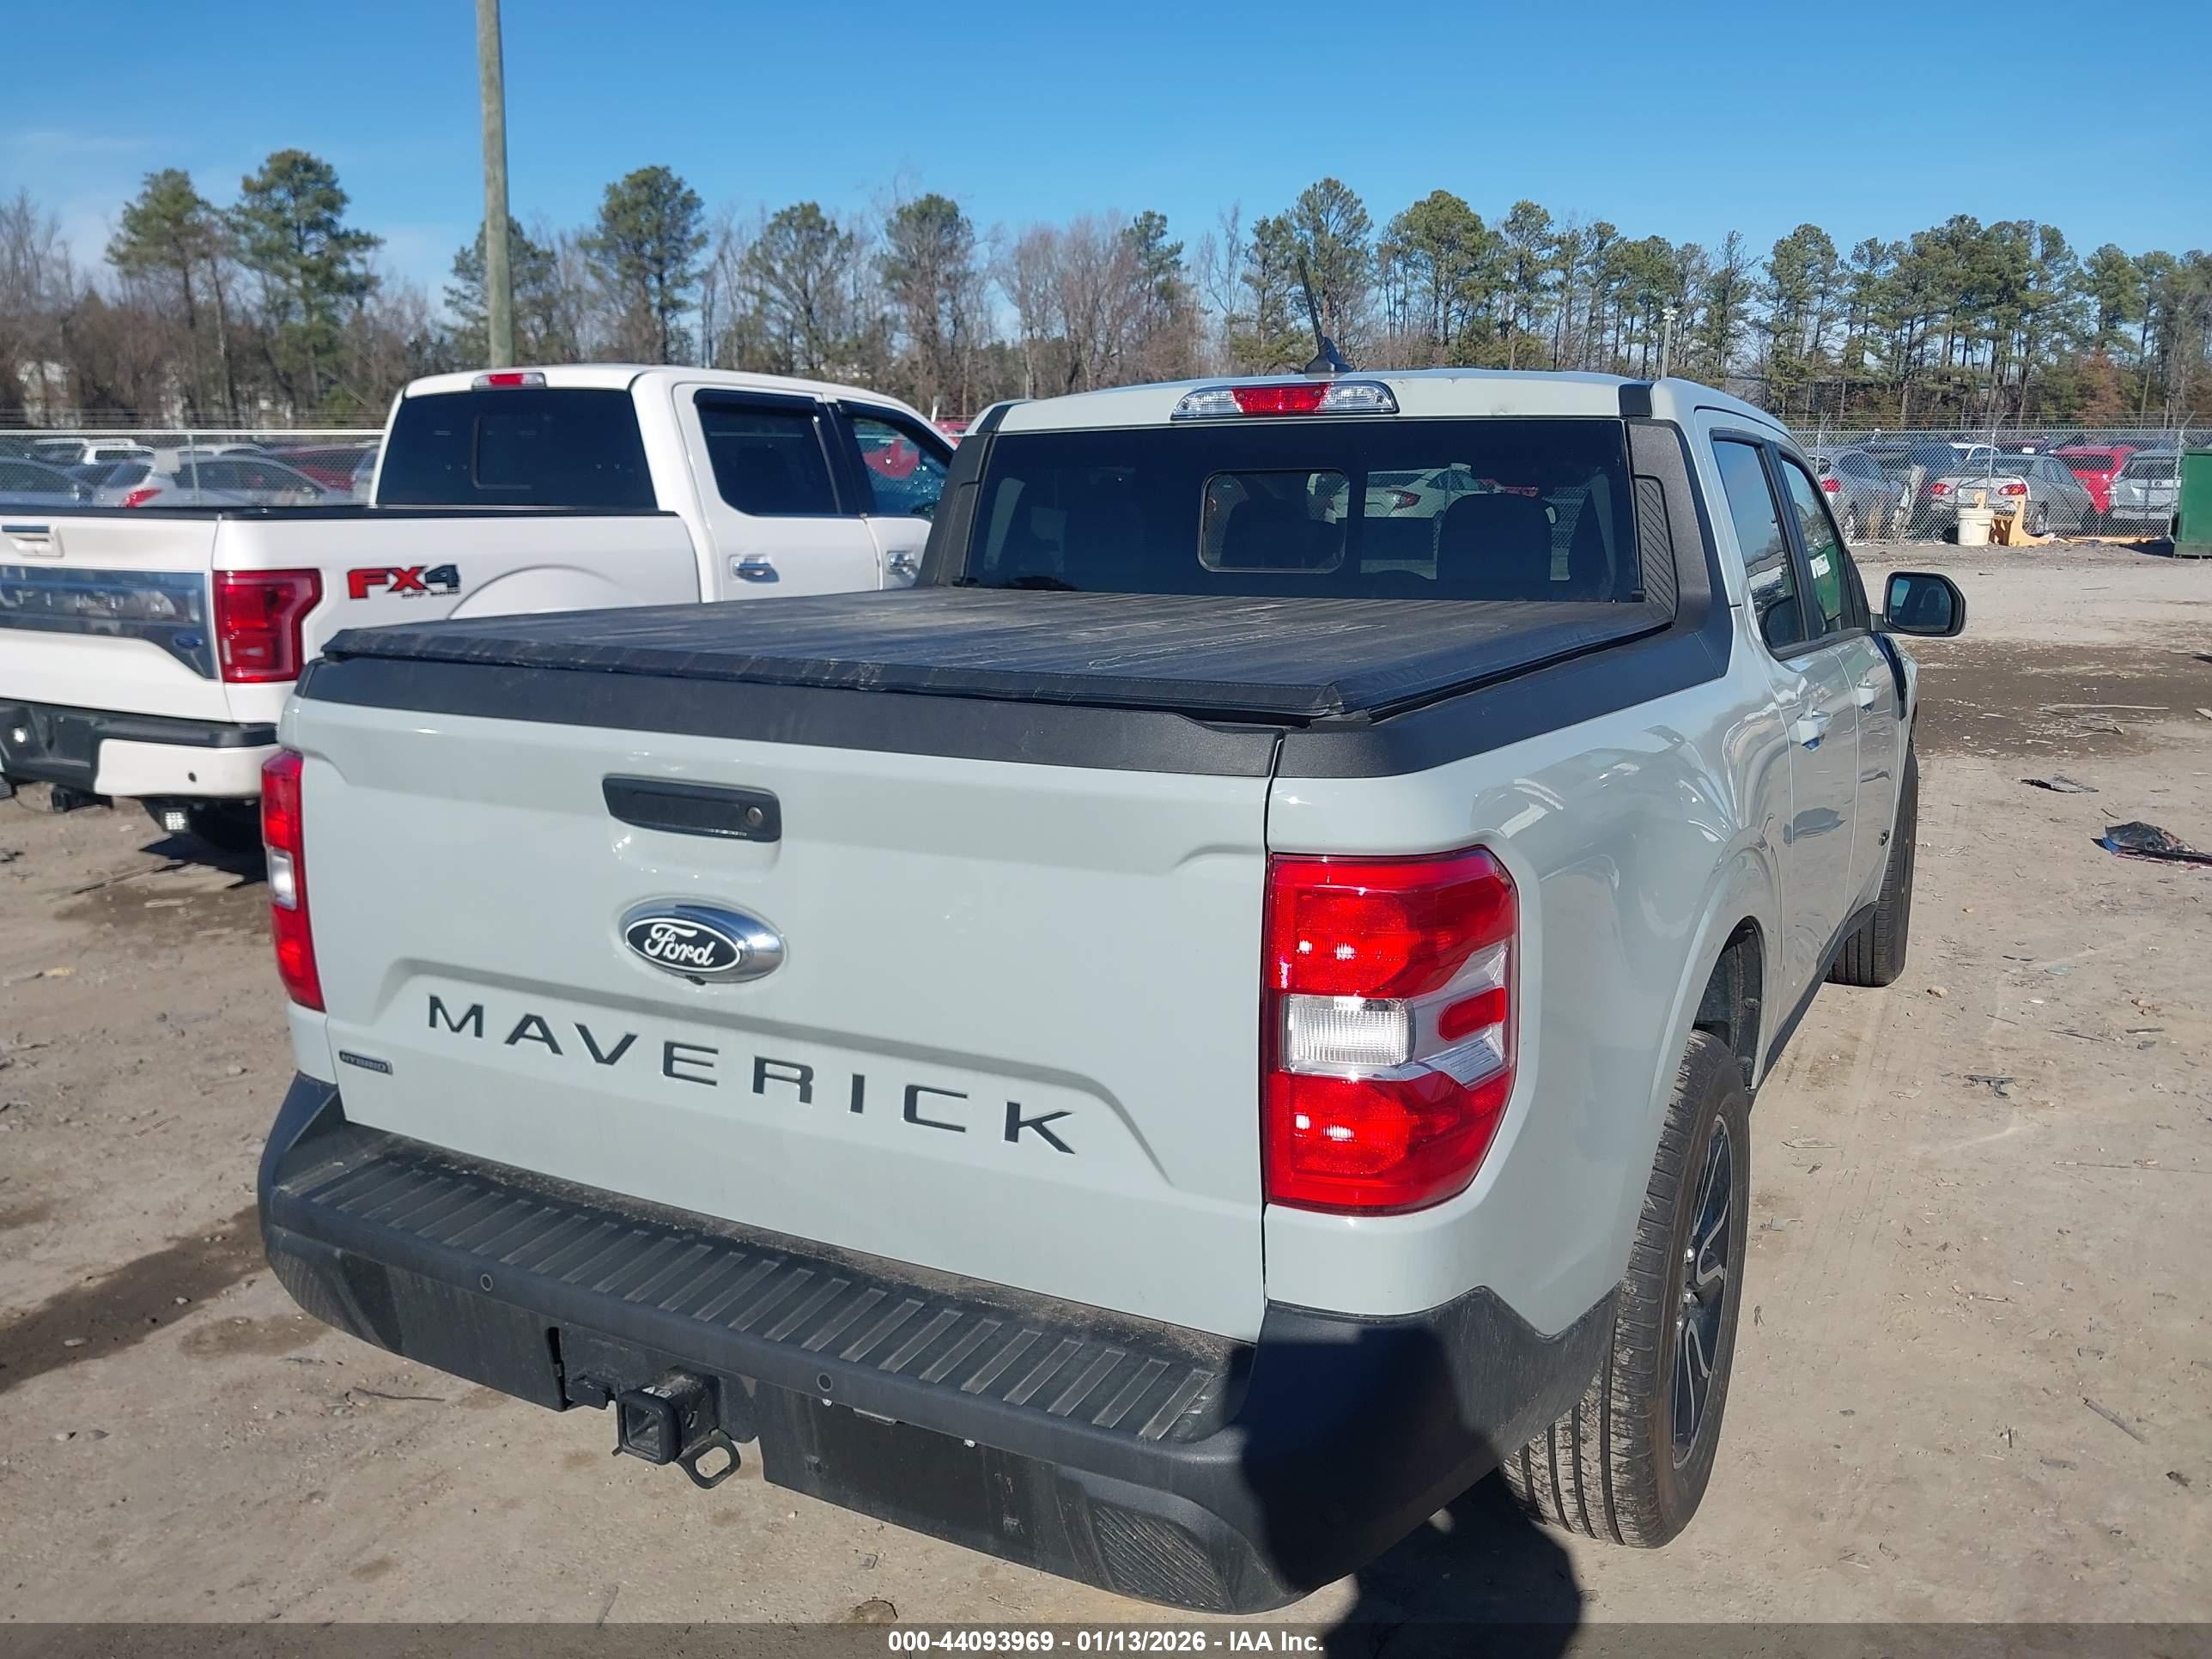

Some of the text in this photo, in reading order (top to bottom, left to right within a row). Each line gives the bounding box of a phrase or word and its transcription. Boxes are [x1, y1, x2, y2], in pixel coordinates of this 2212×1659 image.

[347, 564, 460, 599] FX4
[643, 922, 716, 967] Ford
[428, 994, 1077, 1156] MAVERICK
